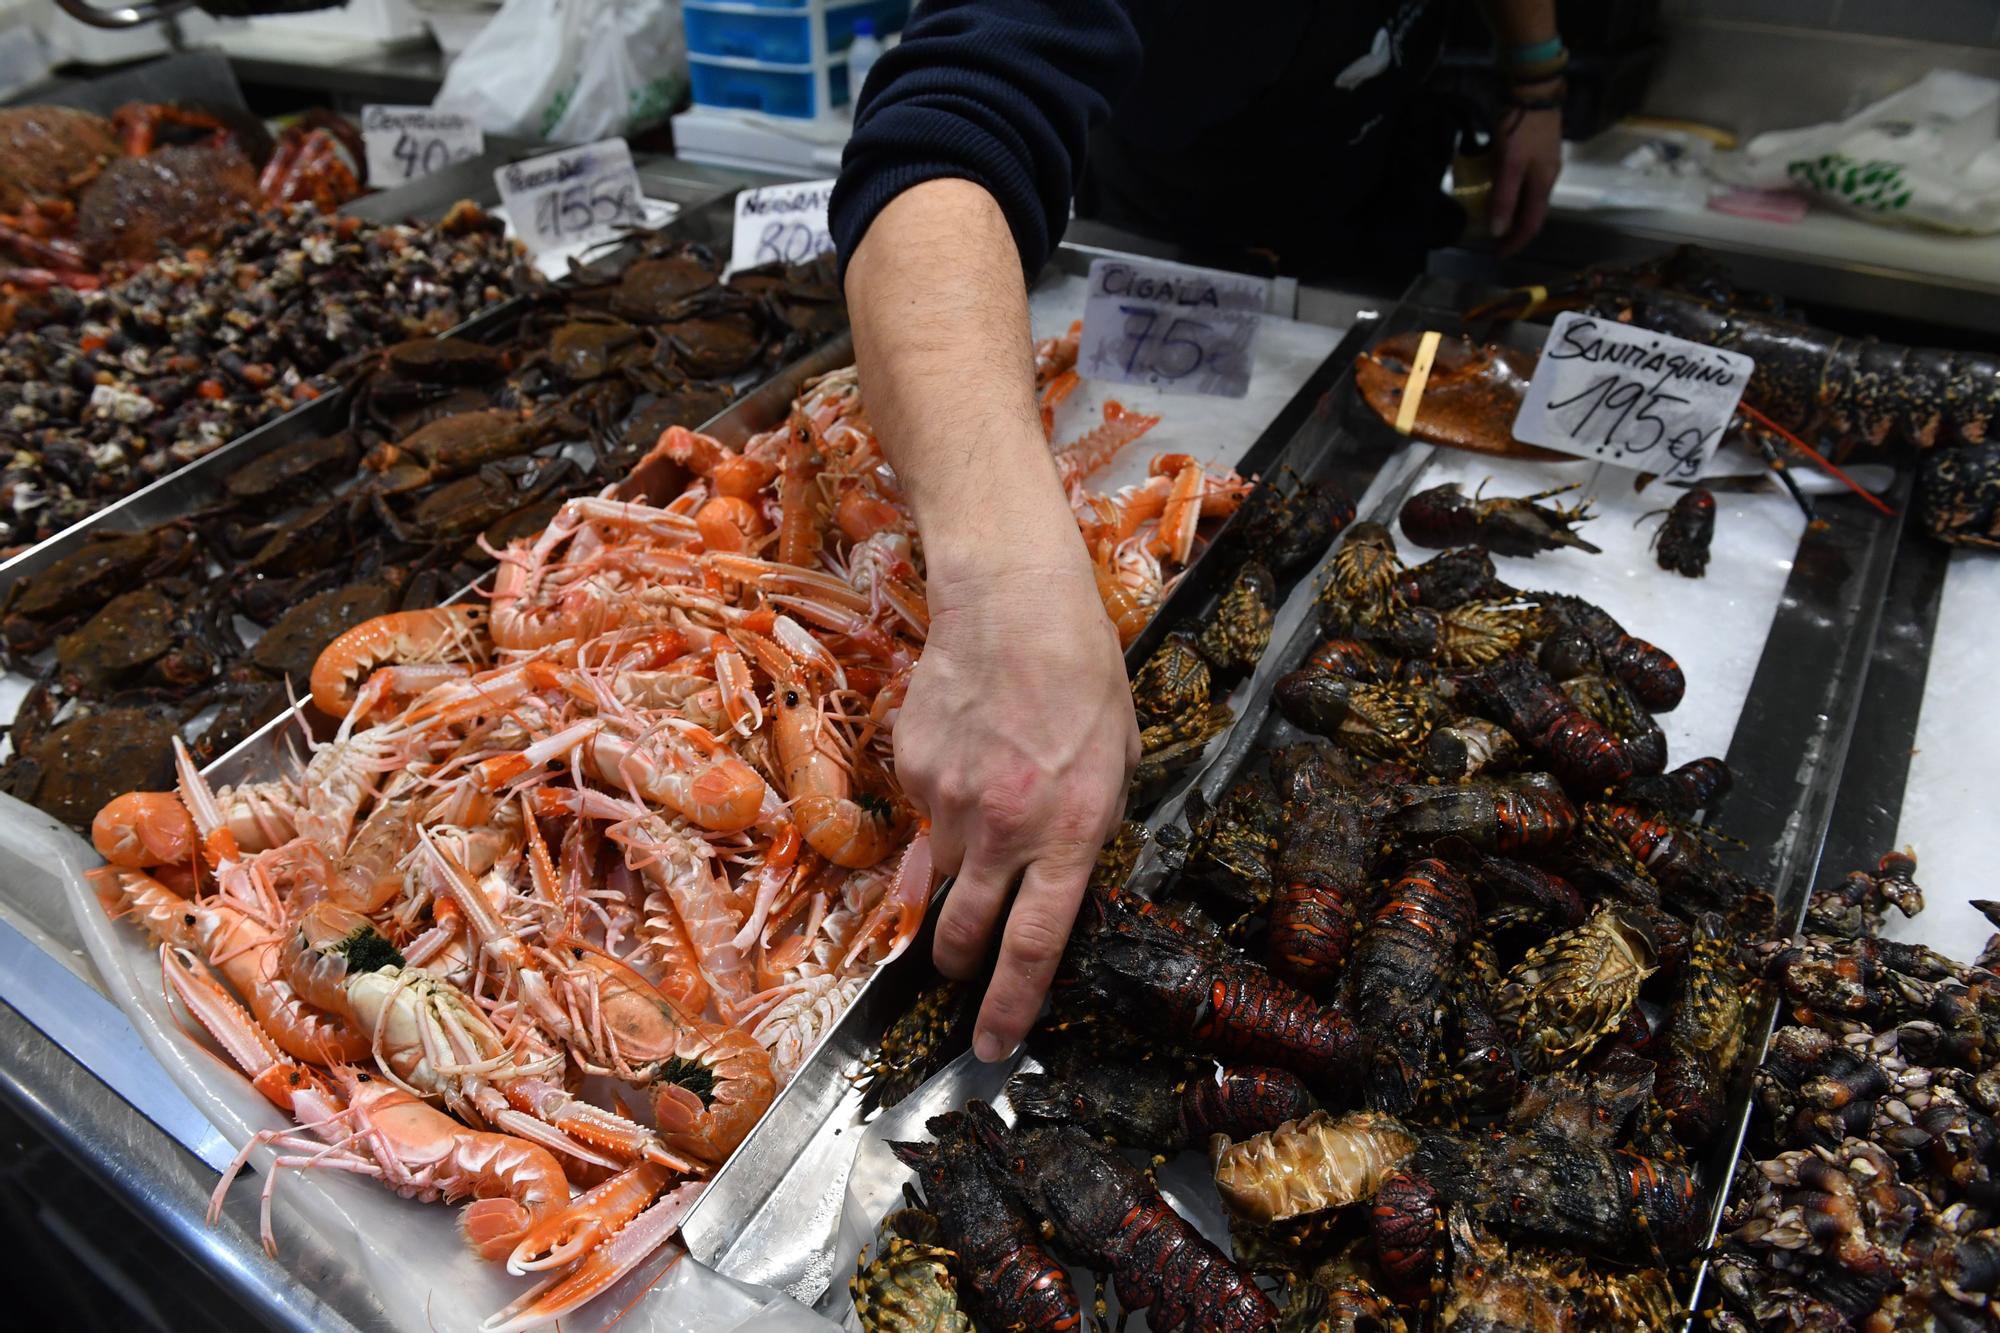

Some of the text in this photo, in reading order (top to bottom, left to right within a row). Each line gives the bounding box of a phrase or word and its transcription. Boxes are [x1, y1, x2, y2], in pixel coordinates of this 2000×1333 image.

[393, 135, 450, 177] 40
[535, 168, 636, 237] 155
[756, 222, 813, 263] 80
[1102, 267, 1219, 308] CIGALA
[1119, 304, 1214, 379] 75
[1547, 375, 1691, 454] 195
